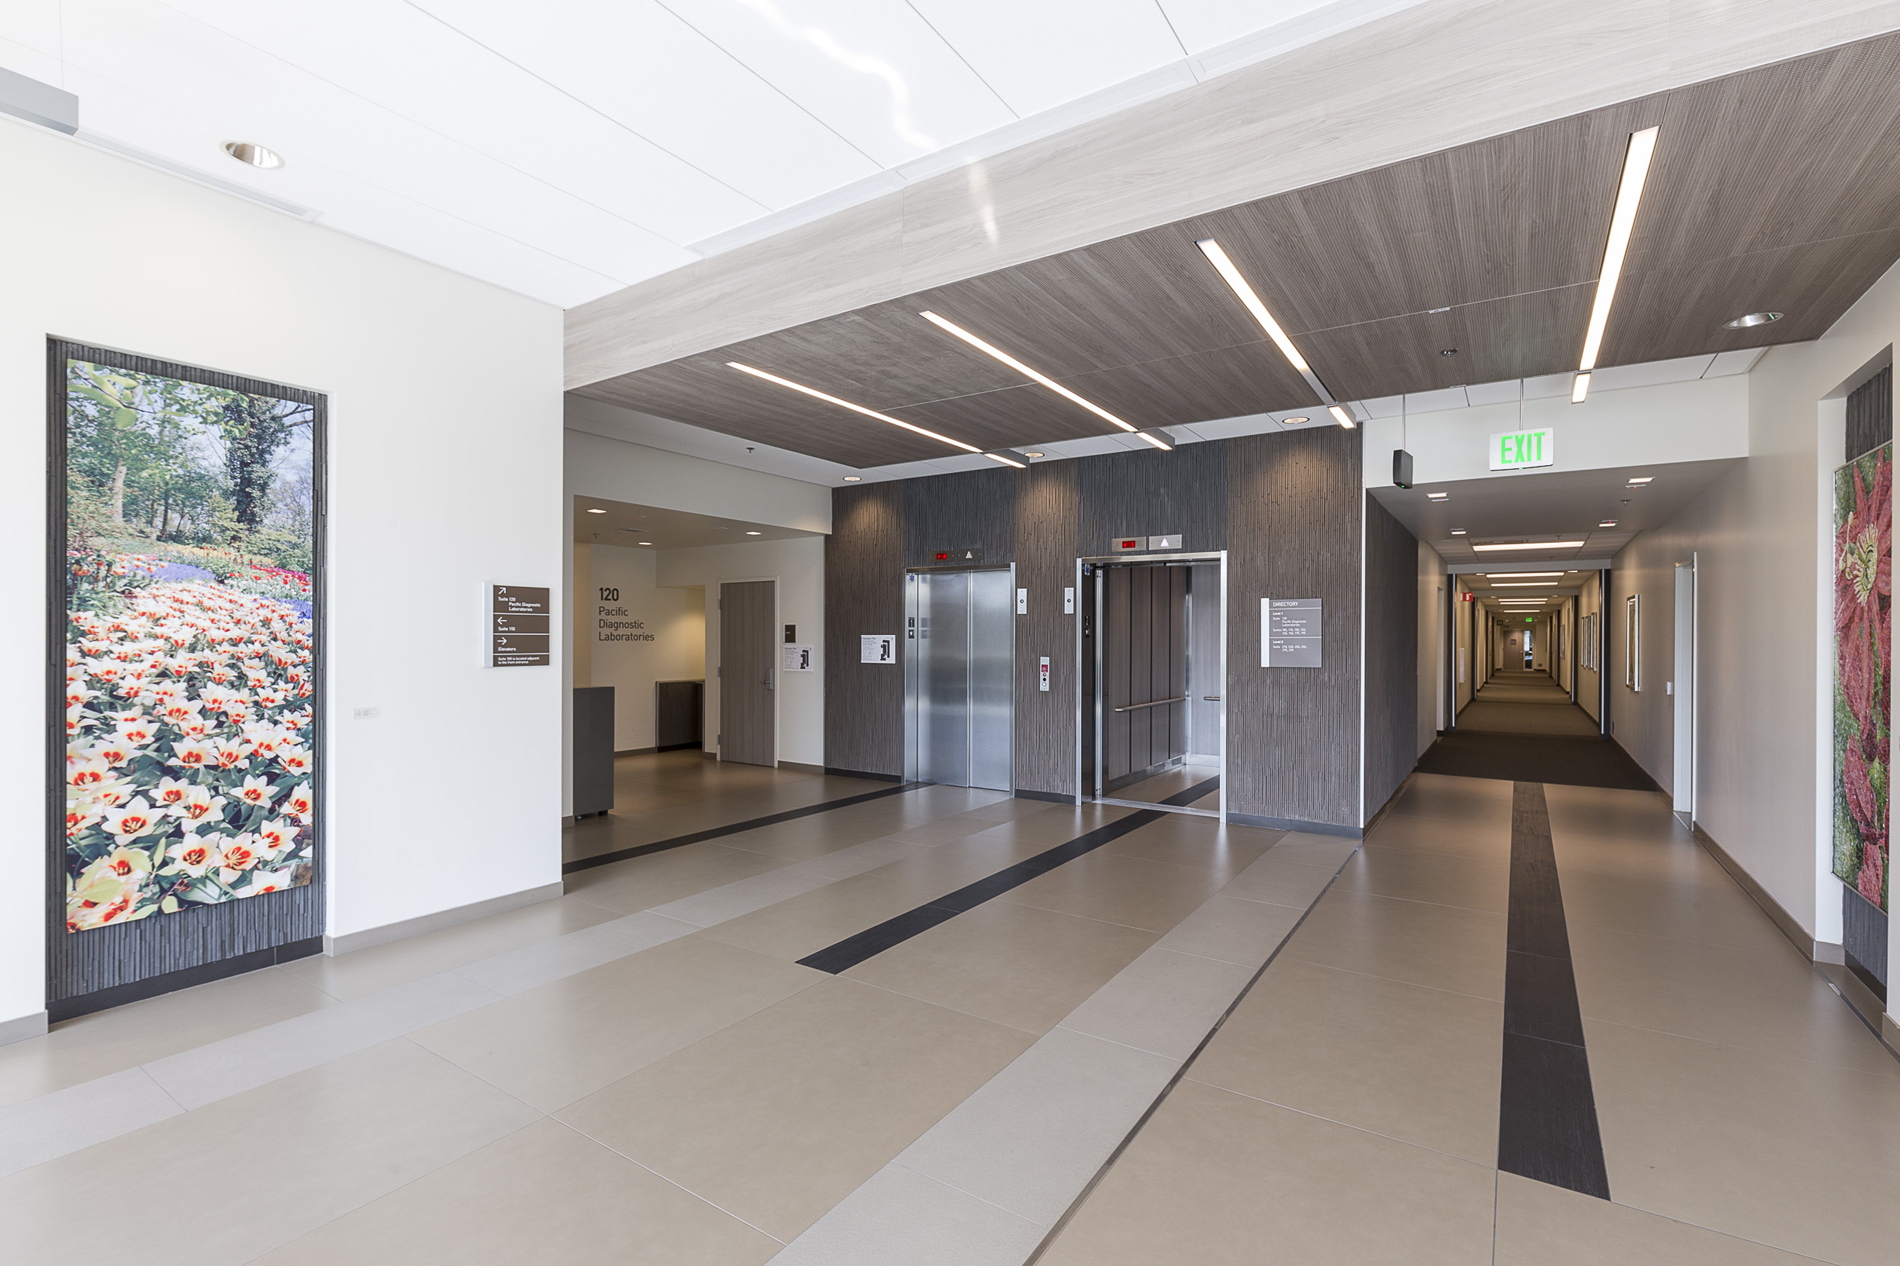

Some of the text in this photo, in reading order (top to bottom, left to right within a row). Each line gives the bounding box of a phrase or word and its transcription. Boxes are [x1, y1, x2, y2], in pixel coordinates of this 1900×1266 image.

[1501, 432, 1545, 464] EXIT
[599, 587, 619, 602] 120
[598, 606, 629, 617] Pacific
[598, 619, 644, 631] Diagnostic
[598, 632, 655, 641] Laboratories
